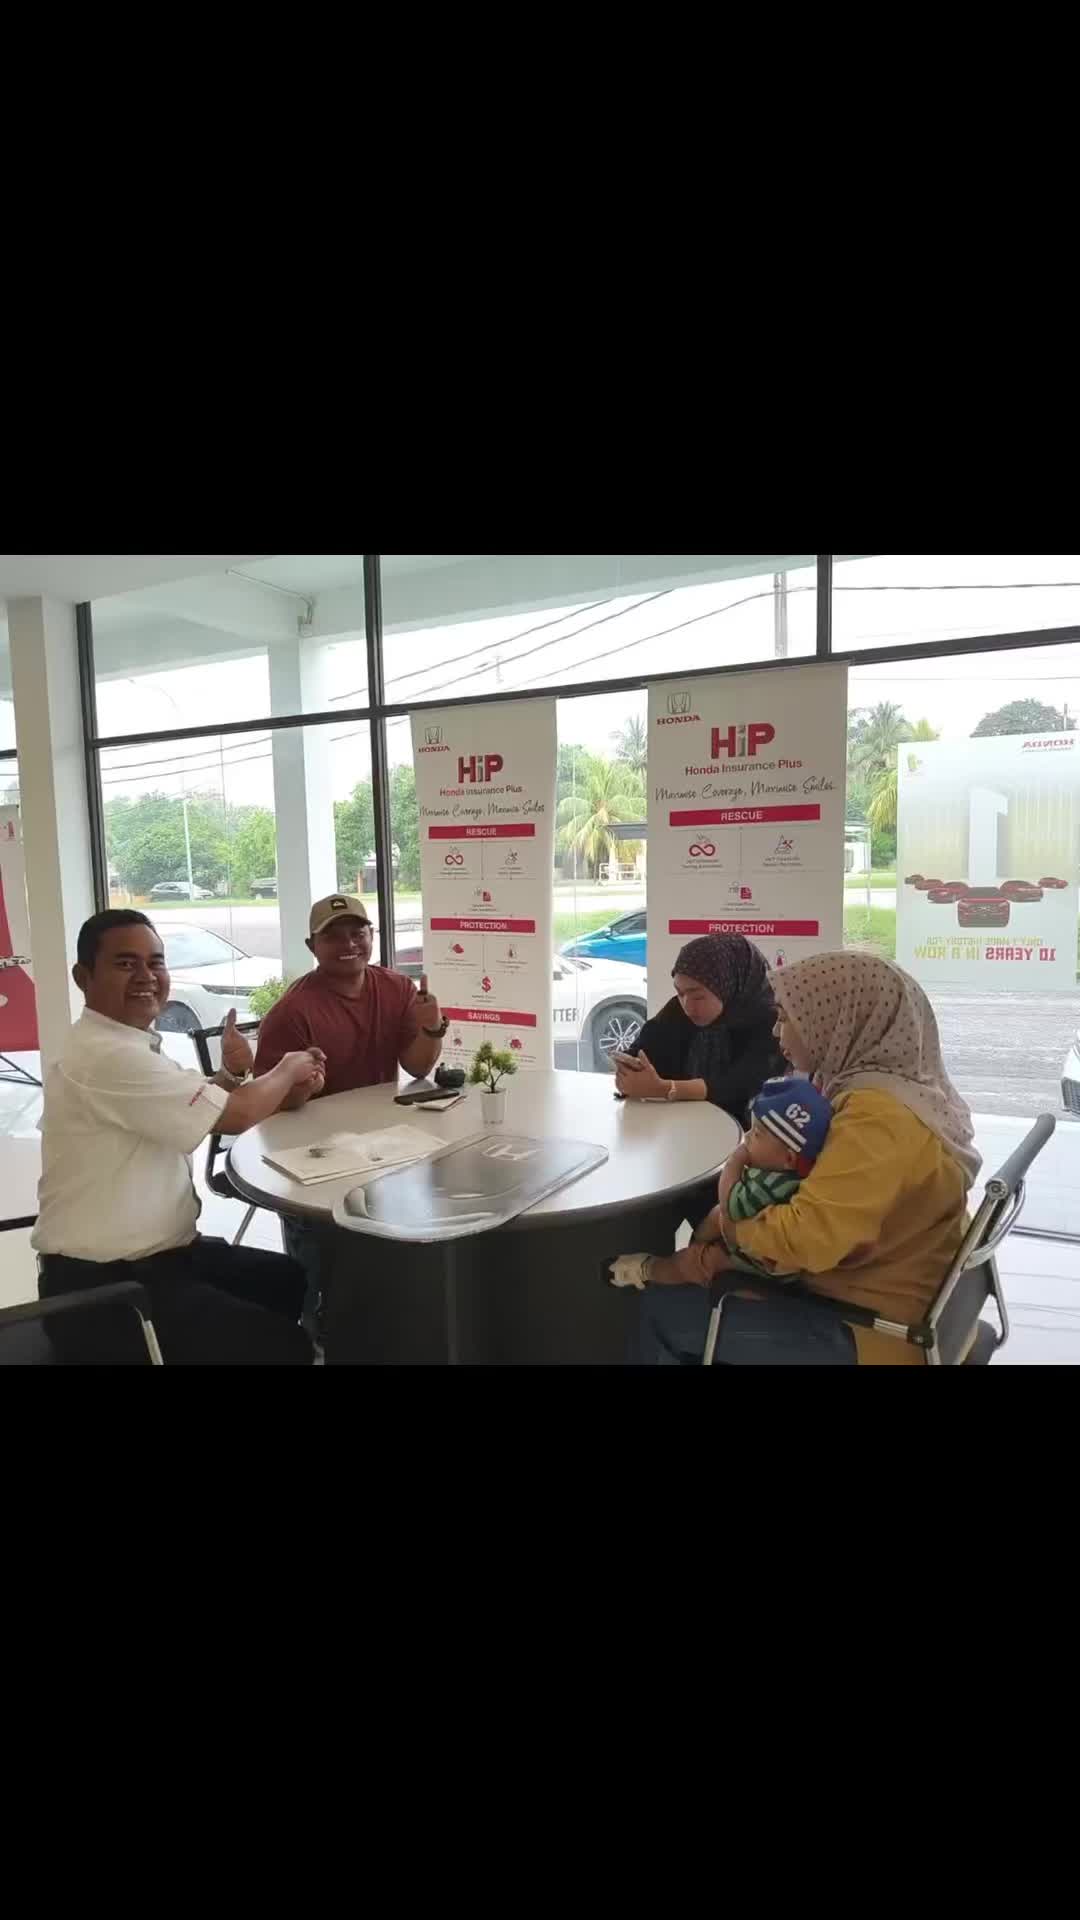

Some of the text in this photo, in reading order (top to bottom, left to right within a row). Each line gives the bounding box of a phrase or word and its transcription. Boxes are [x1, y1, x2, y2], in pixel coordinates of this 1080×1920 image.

[657, 714, 701, 725] HONDA
[711, 723, 775, 759] HiP
[418, 745, 450, 753] HONDA
[458, 754, 503, 783] HiP
[685, 759, 802, 776] Honda Insurance Plus
[440, 784, 523, 797] Honda Insurance Plus
[721, 811, 763, 822] RESCUE
[466, 827, 497, 836] RESCUE
[460, 921, 508, 930] PROTECTION
[708, 923, 775, 934] PROTECTION
[468, 1011, 501, 1021] SAVINGS
[785, 1103, 811, 1129] 62
